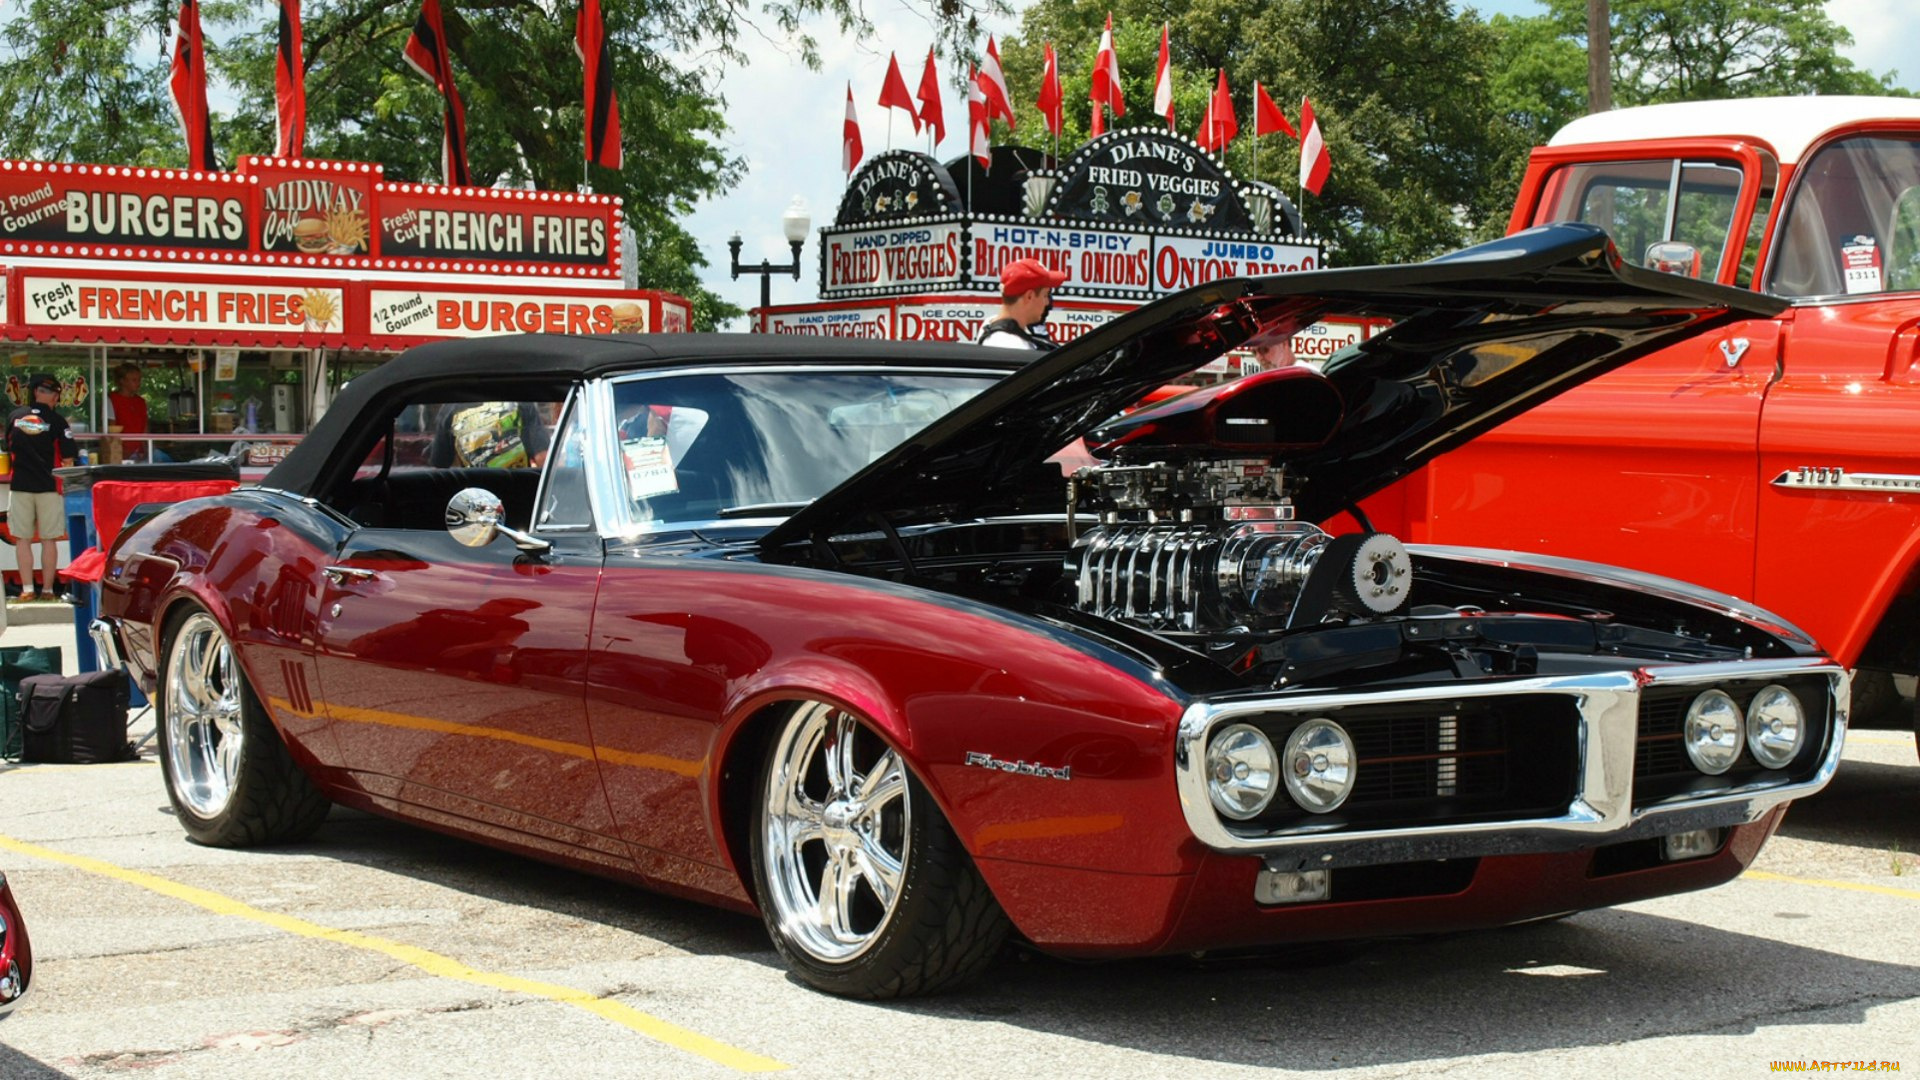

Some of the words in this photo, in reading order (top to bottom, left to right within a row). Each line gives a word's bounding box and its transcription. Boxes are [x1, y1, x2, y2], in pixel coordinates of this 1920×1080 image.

[1110, 140, 1196, 173] DIANE'S
[858, 160, 920, 198] DIANE'S
[1088, 166, 1142, 187] FRIED
[1147, 173, 1220, 197] VEGGIES
[9, 182, 53, 211] Pound
[265, 180, 363, 214] MIDWAY
[66, 191, 243, 241] BURGERS
[382, 208, 417, 232] Fresh
[394, 223, 420, 244] Cut
[418, 210, 522, 252] FRENCH
[533, 216, 605, 256] FRIES
[854, 236, 887, 249] HAND
[891, 230, 931, 245] DIPPED
[831, 243, 881, 285] FRIED
[884, 231, 957, 281] VEGGIES
[1202, 242, 1274, 261] JUMBO
[1081, 248, 1148, 286] ONIONS
[1157, 245, 1238, 290] ONION
[1848, 270, 1877, 280] 1311
[32, 282, 73, 308] Fresh
[79, 287, 207, 322] FRENCH
[218, 292, 305, 325] FRIES
[373, 308, 389, 323] 1/2
[390, 293, 423, 316] Pound
[46, 299, 77, 321] Cut
[386, 304, 434, 333] Gourmet
[437, 299, 614, 335] BURGERS
[799, 316, 824, 324] HAND
[828, 313, 860, 323] DIPPED
[922, 310, 943, 318] ICE
[947, 310, 985, 318] COLD
[1067, 313, 1104, 322] HAND
[1796, 466, 1844, 484] 3100
[965, 751, 1070, 780] Firebird
